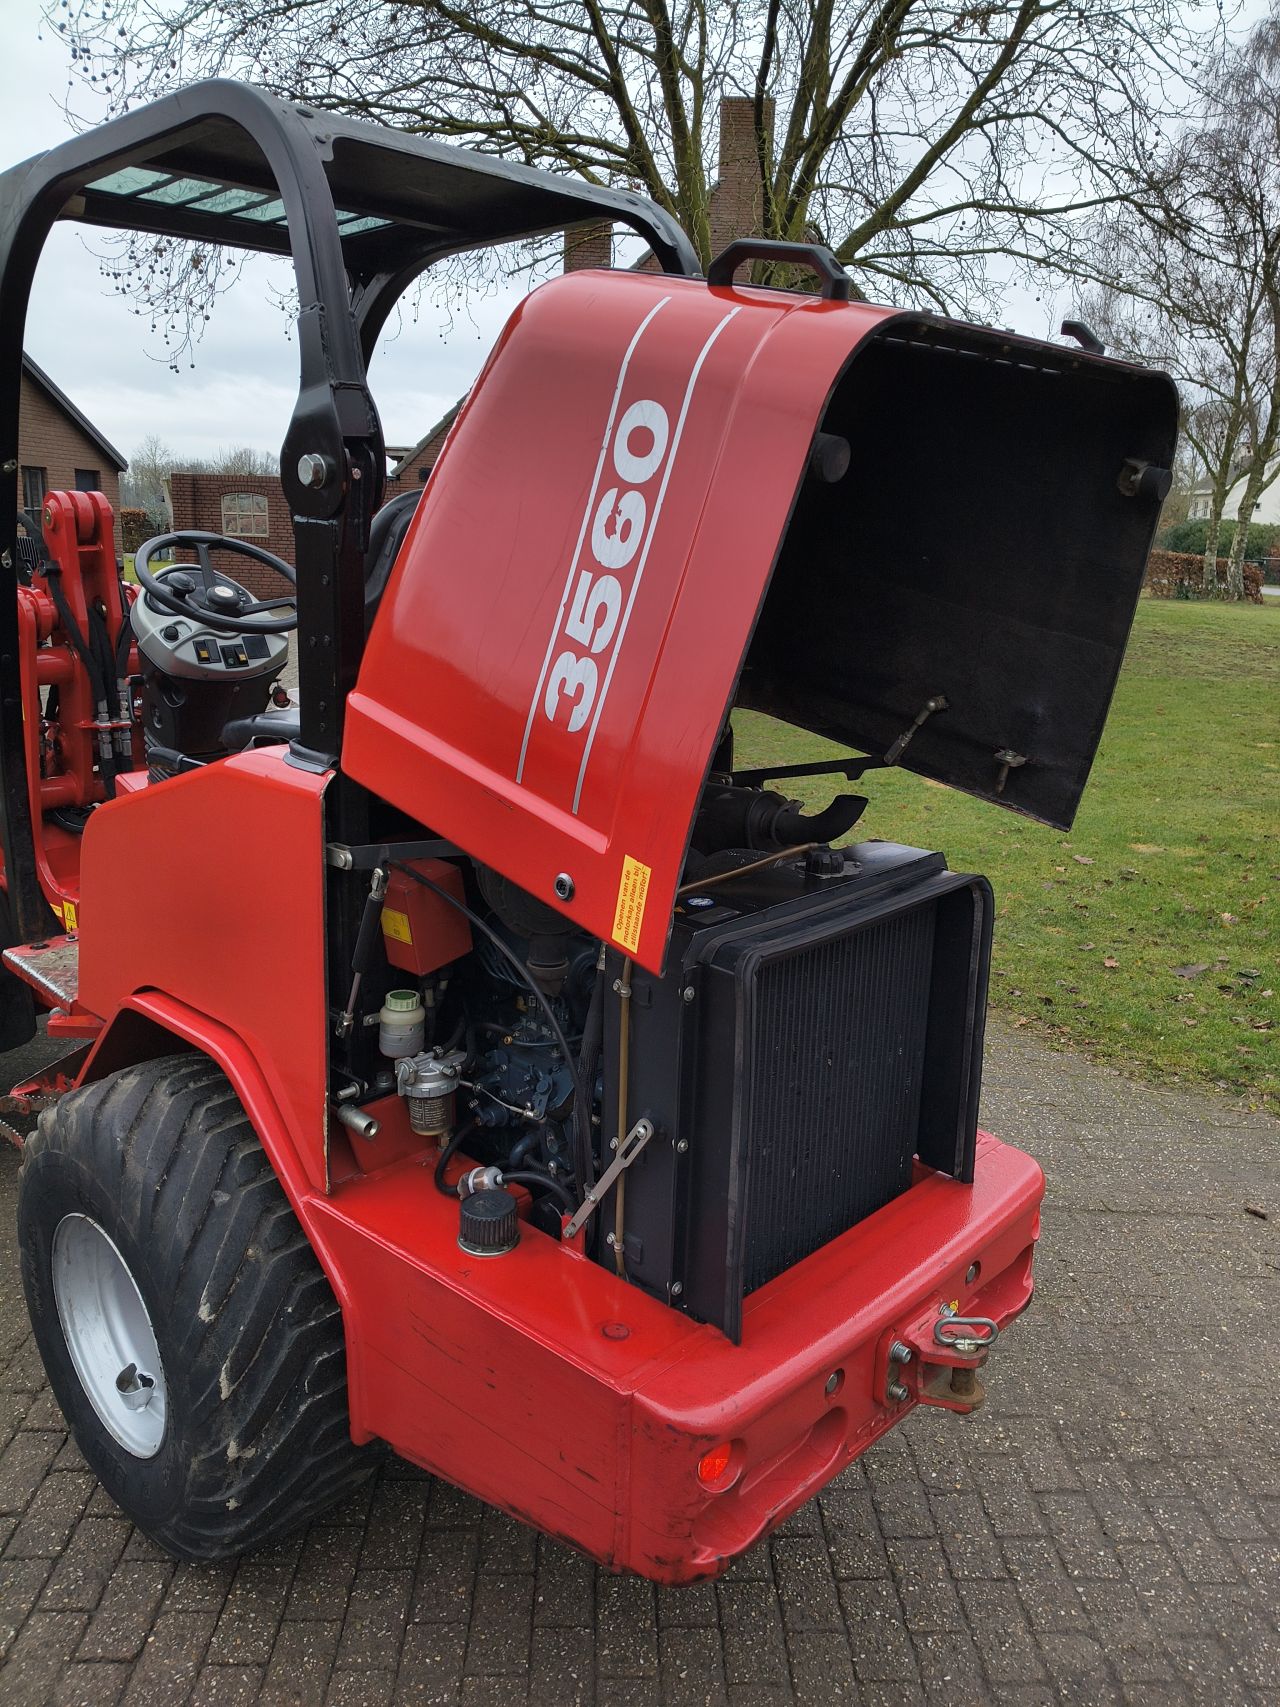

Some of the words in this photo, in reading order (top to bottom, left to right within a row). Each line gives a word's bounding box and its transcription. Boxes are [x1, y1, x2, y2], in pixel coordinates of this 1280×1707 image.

[544, 399, 669, 732] 3560
[629, 878, 638, 903] alleen
[633, 865, 641, 877] bij
[616, 898, 626, 930] Openen
[624, 869, 631, 880] de
[623, 904, 634, 943] motorkap
[630, 901, 642, 945] stilstaande
